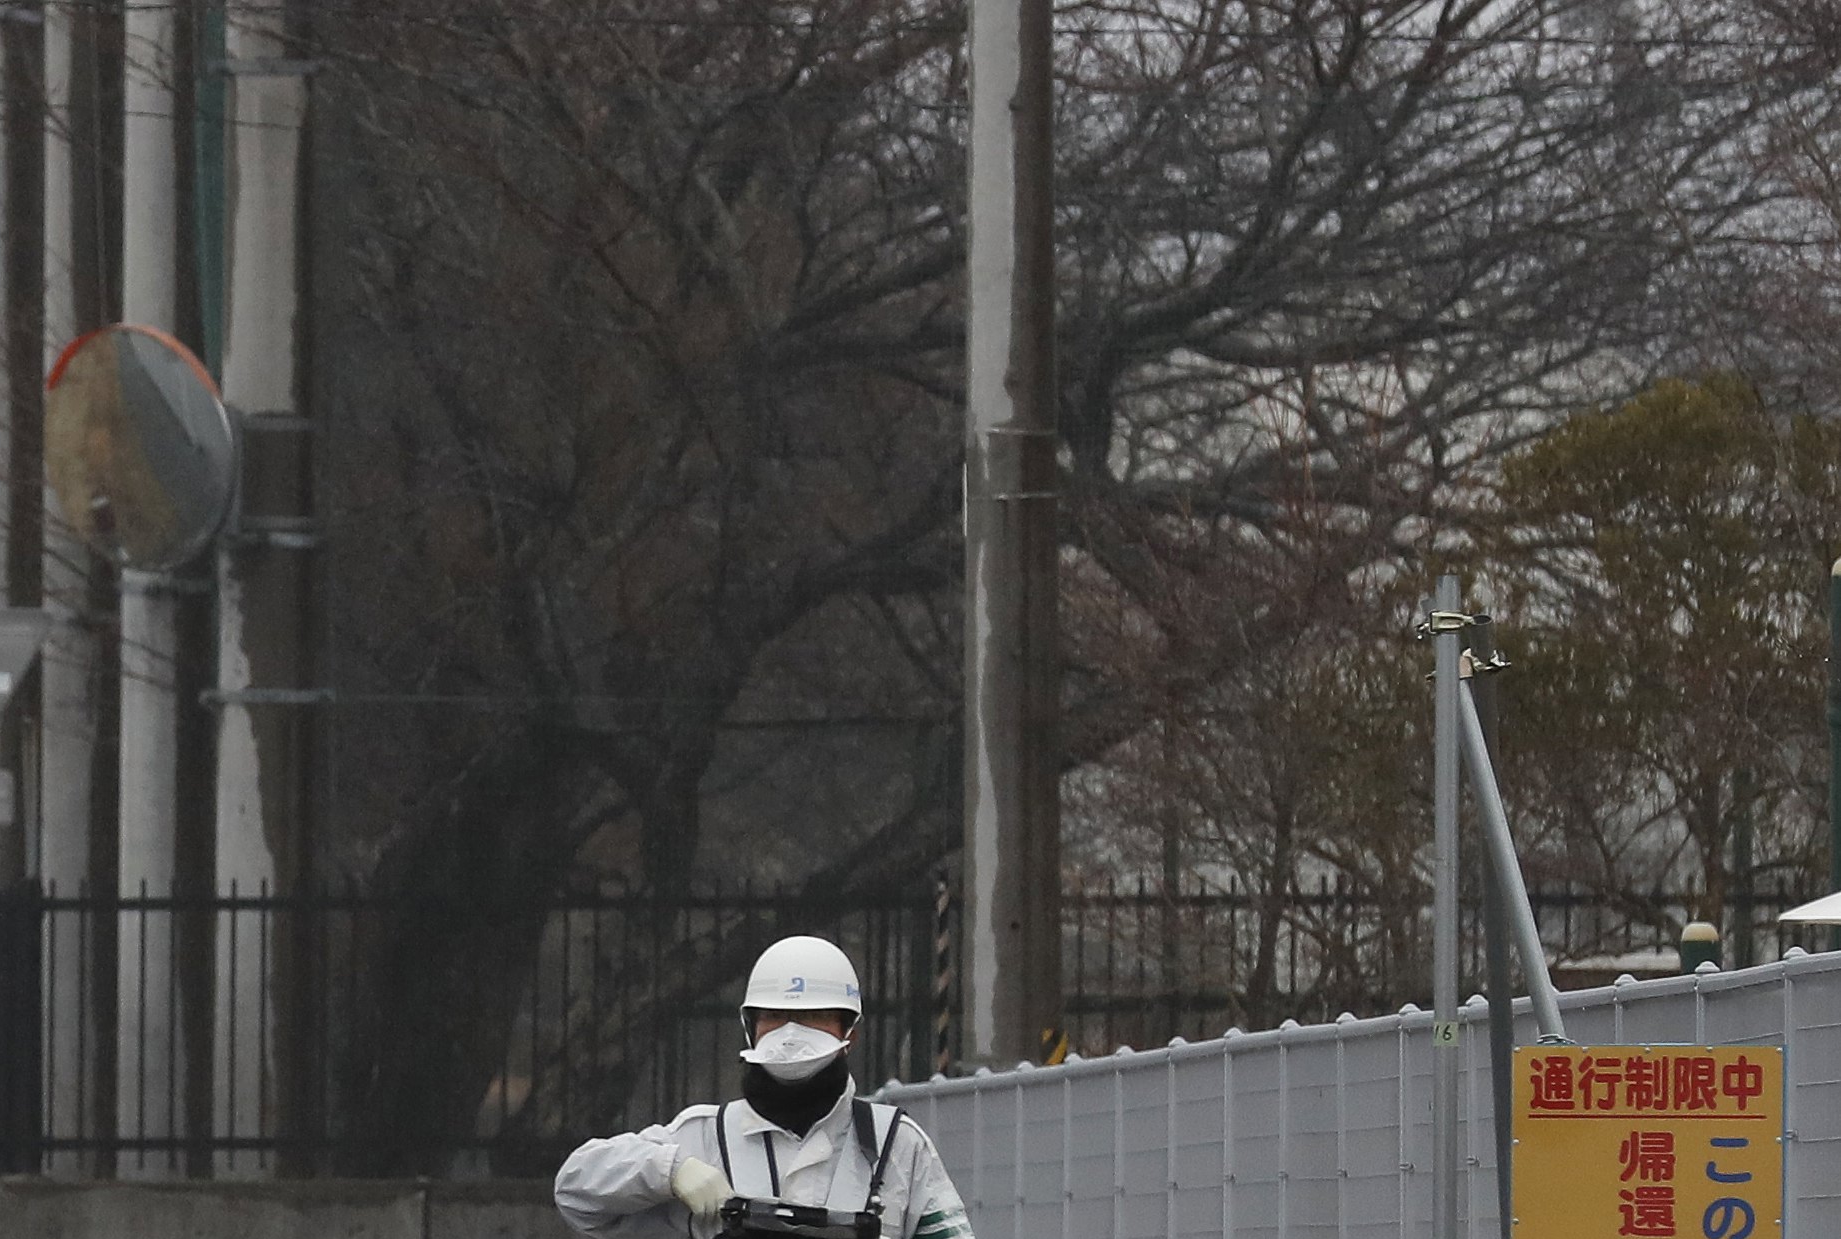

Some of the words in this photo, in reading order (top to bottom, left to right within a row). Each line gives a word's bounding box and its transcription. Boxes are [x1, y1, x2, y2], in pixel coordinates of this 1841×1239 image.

[1434, 1024, 1452, 1041] 16
[1530, 1055, 1764, 1111] 通行制限中
